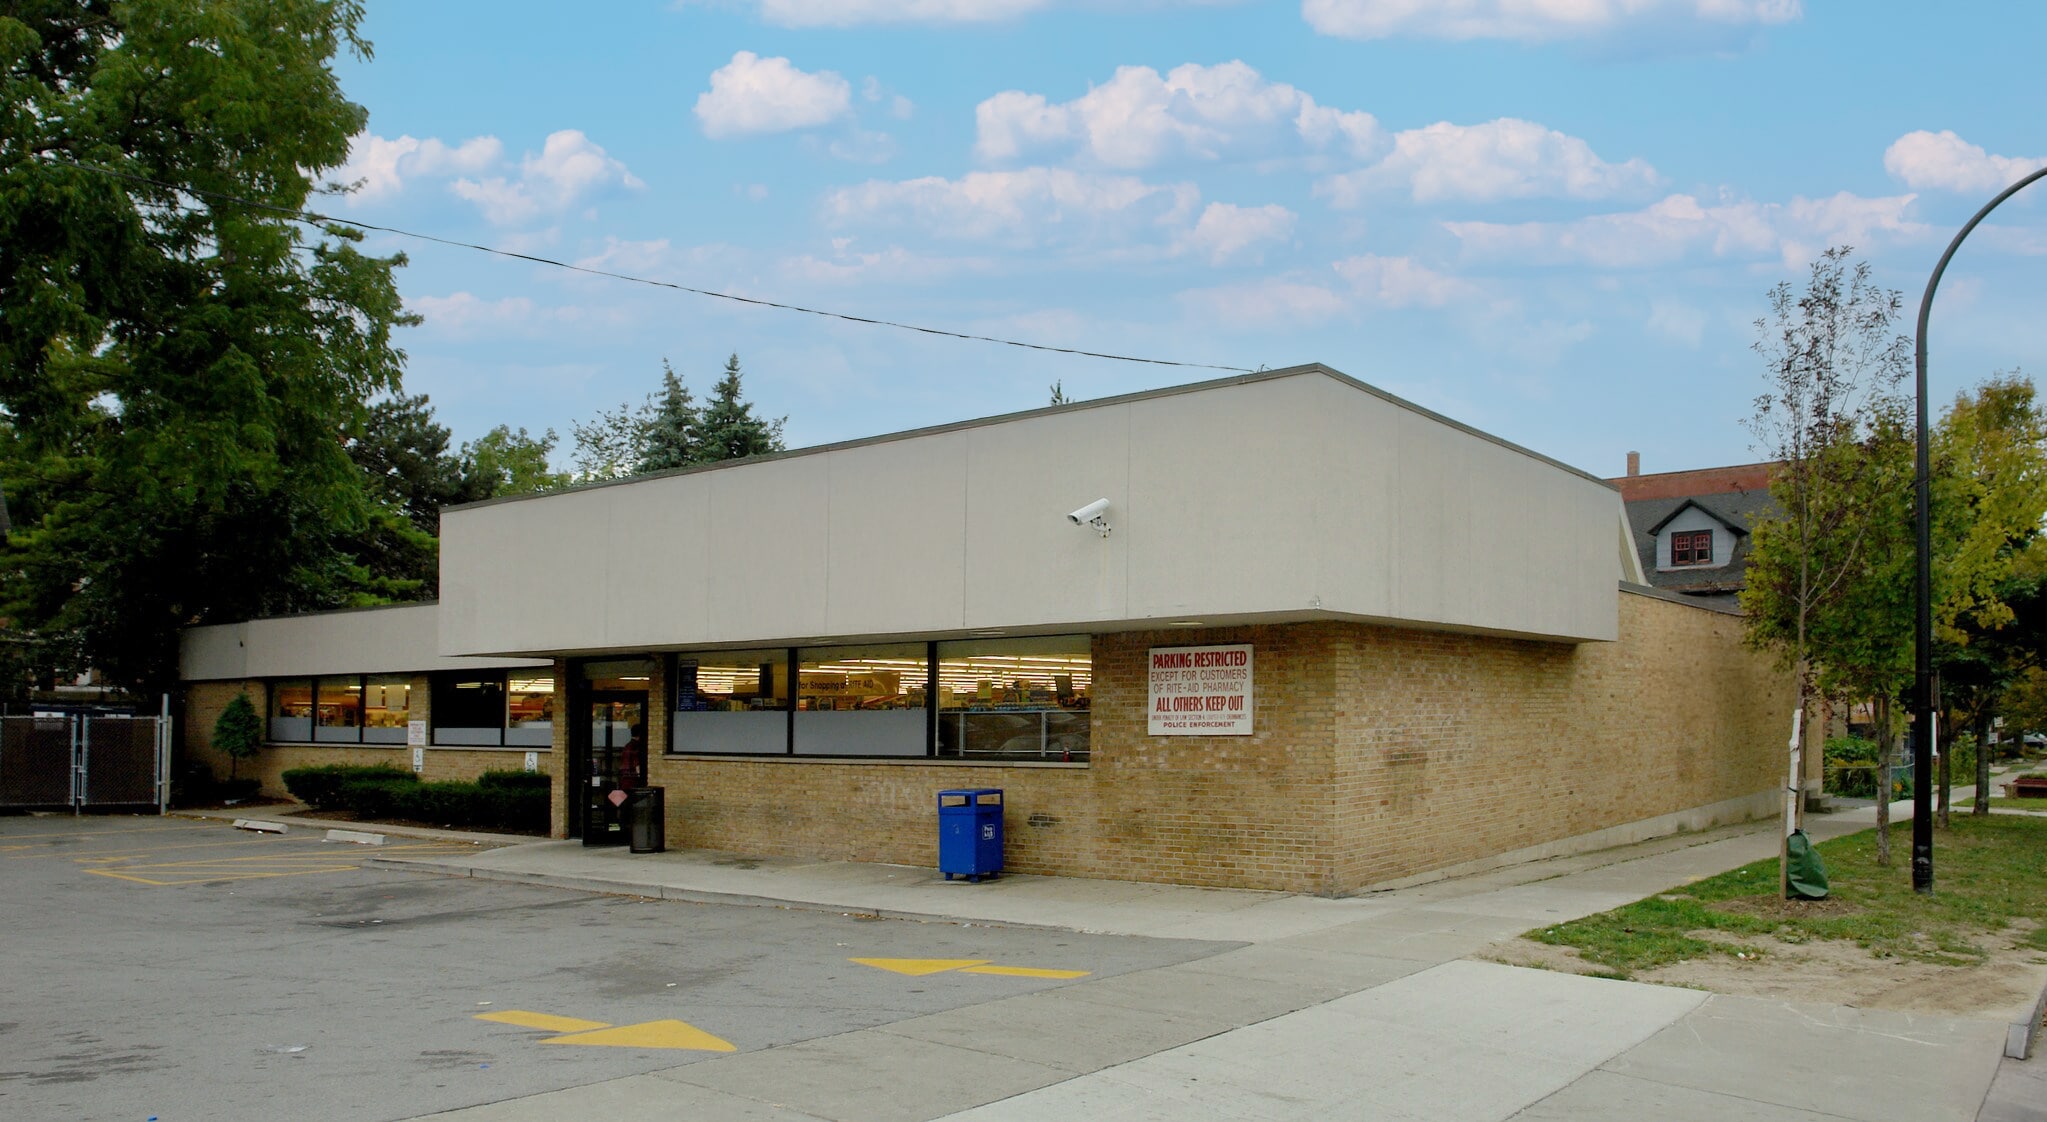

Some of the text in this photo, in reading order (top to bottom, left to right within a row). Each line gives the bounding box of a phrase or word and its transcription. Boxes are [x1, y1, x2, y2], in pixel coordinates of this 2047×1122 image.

[1153, 651, 1247, 669] PARKING RESTRICTED
[1151, 669, 1247, 682] EXCEPT FOR CUSTOMERS
[811, 681, 839, 691] Shopping
[1153, 684, 1163, 694] OF
[1203, 681, 1244, 693] PHARMACY
[1156, 695, 1244, 712] ALL OTHERS KEEP OUT
